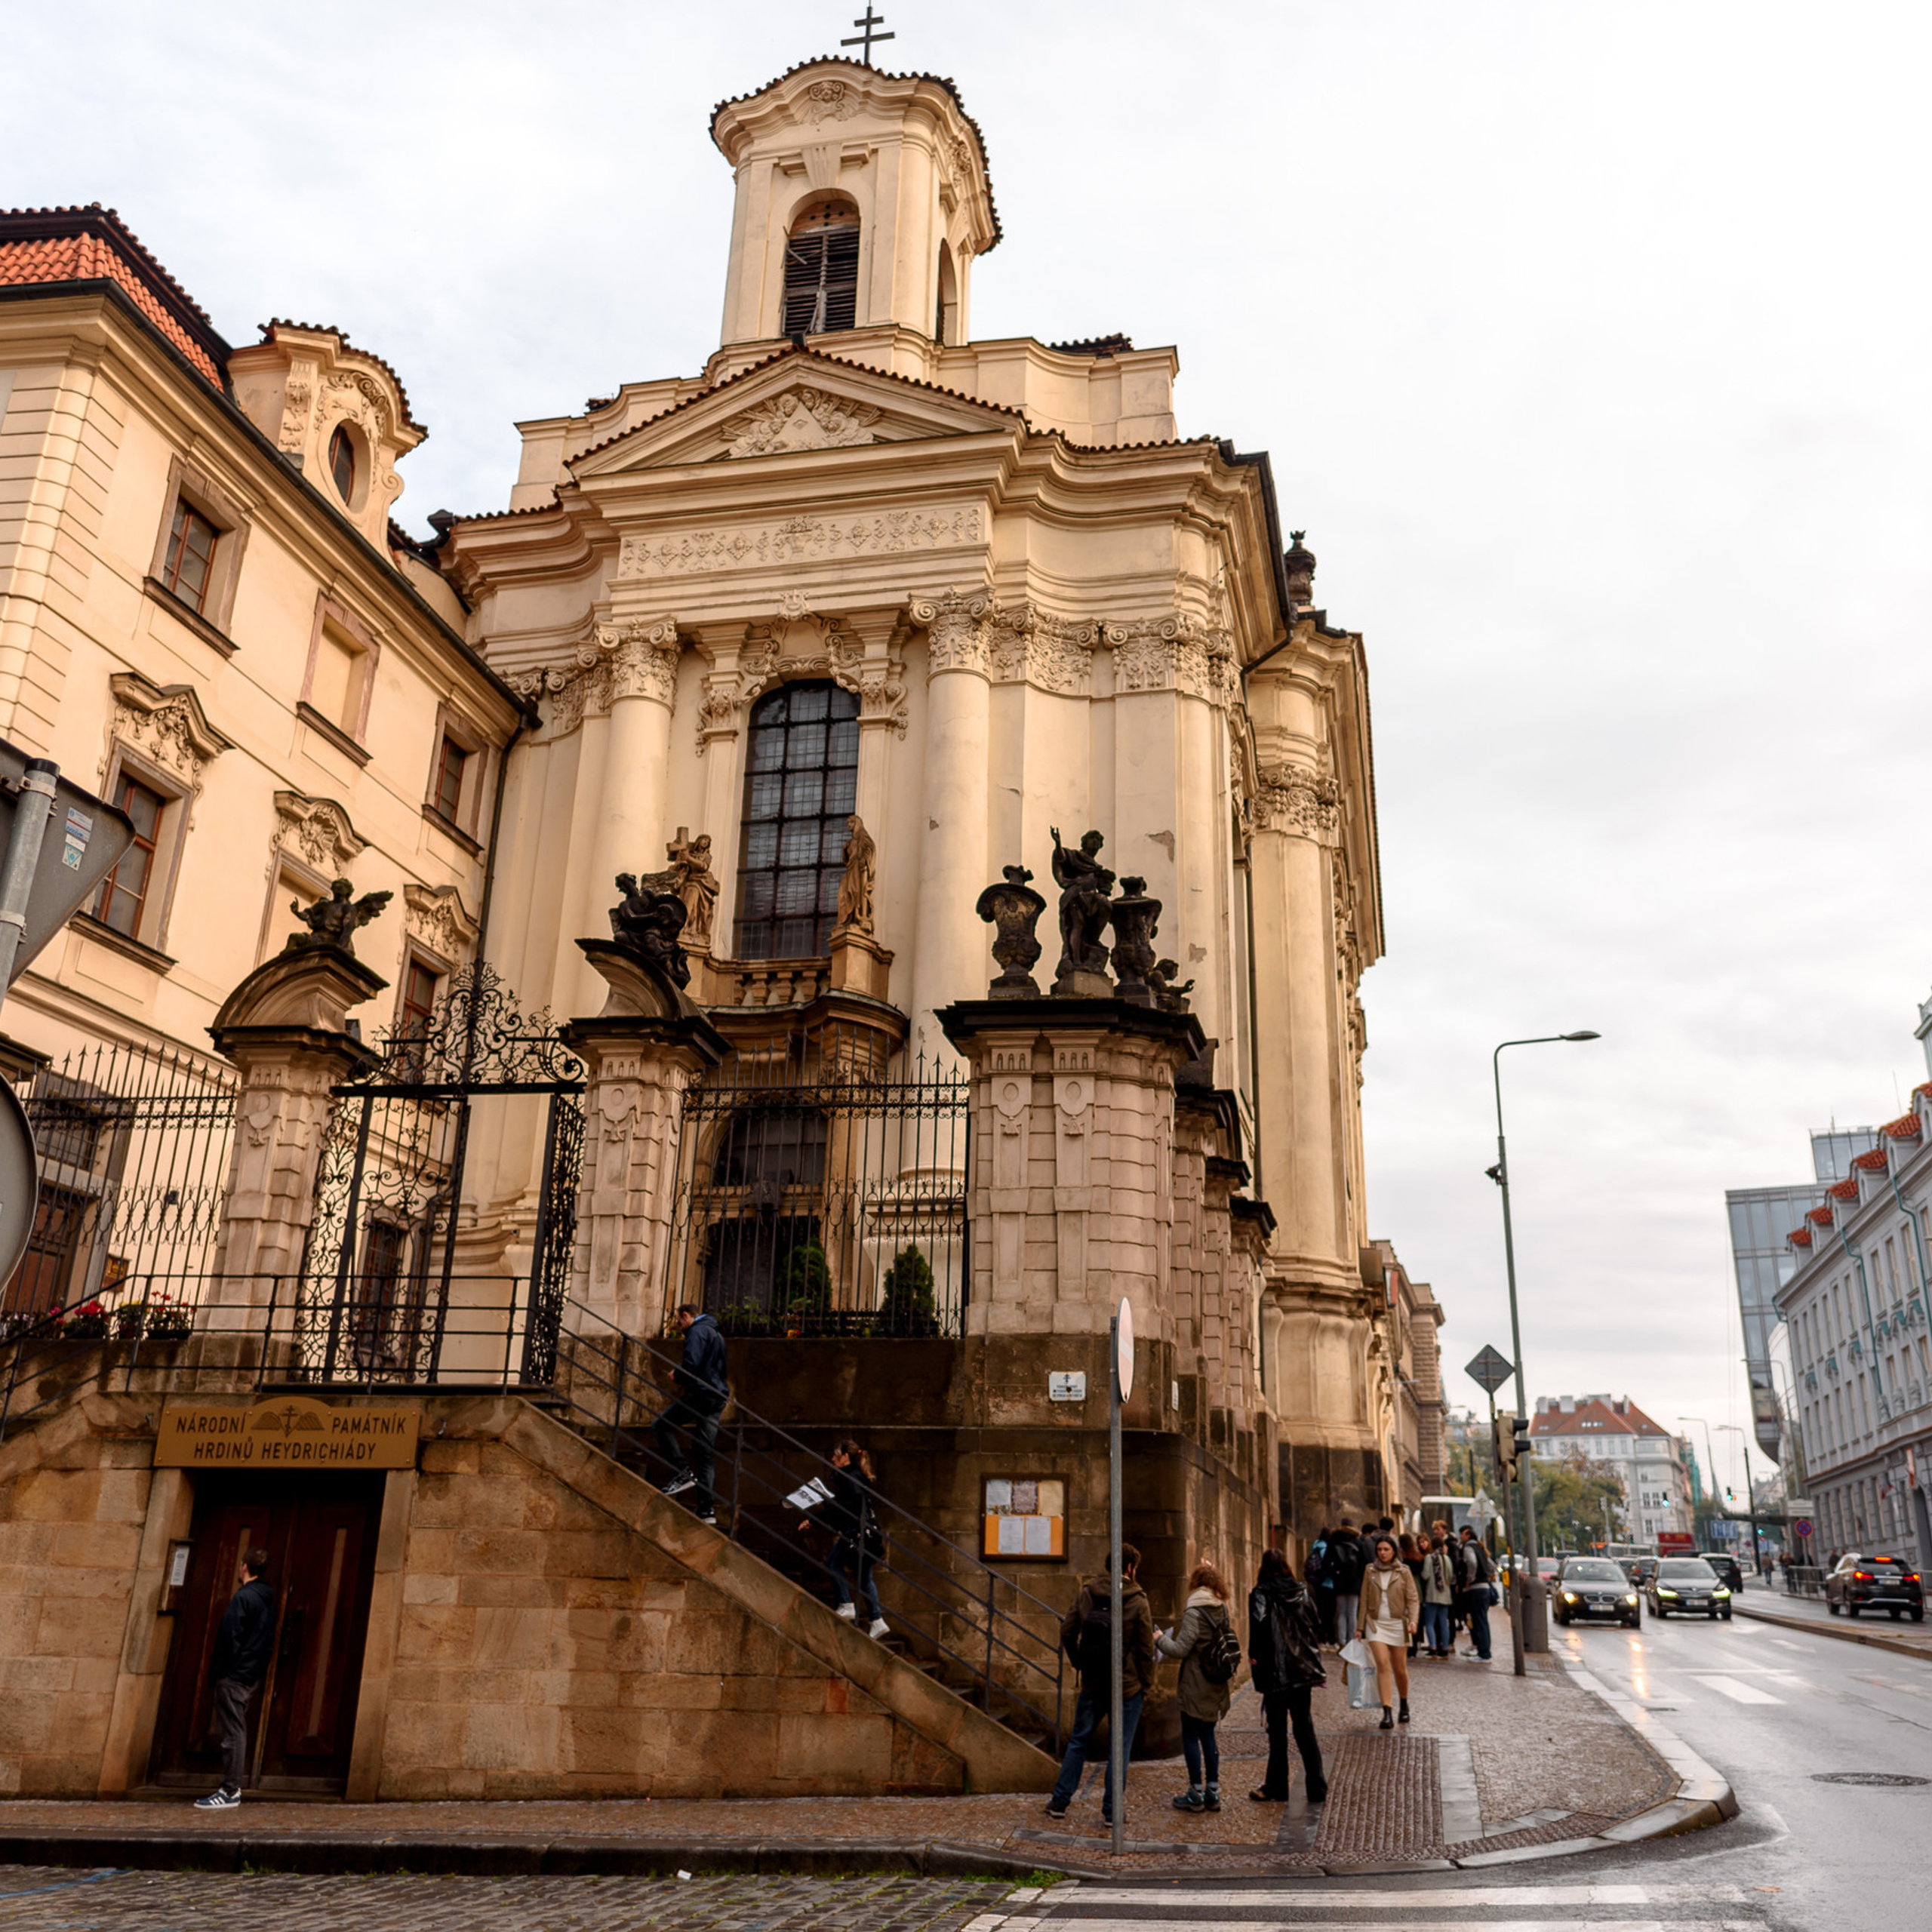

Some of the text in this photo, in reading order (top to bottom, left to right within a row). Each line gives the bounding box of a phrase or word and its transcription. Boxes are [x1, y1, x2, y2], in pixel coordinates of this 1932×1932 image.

[176, 1411, 406, 1434] NÁRODNÍ PAMÁTNÍK
[193, 1436, 377, 1460] HRDINŮ HEYDRICHIÁDY
